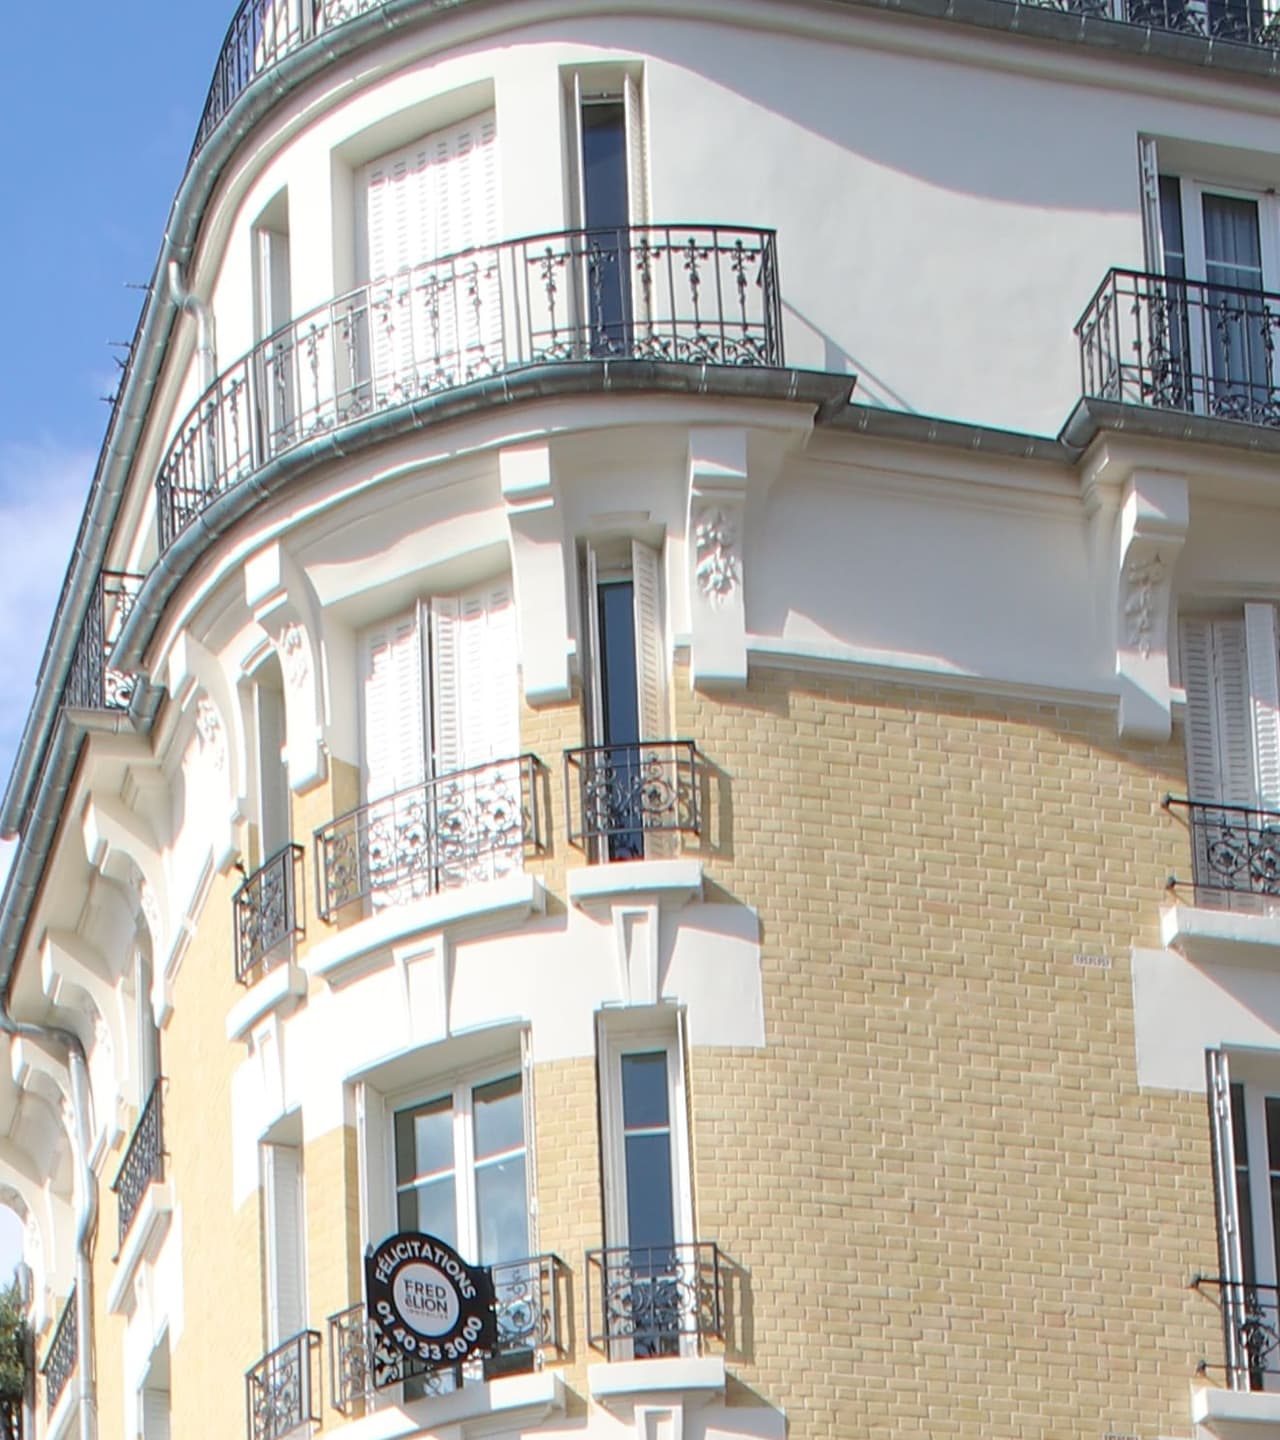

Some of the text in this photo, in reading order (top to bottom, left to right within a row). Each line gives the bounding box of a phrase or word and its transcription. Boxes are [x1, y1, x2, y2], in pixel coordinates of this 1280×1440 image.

[376, 1240, 477, 1299] FÉLICITATIONS
[404, 1279, 446, 1299] FRED
[377, 1301, 396, 1326] 01
[394, 1327, 416, 1351] 40
[419, 1342, 442, 1360] 33
[444, 1337, 468, 1359] 30
[463, 1316, 483, 1342] 00
